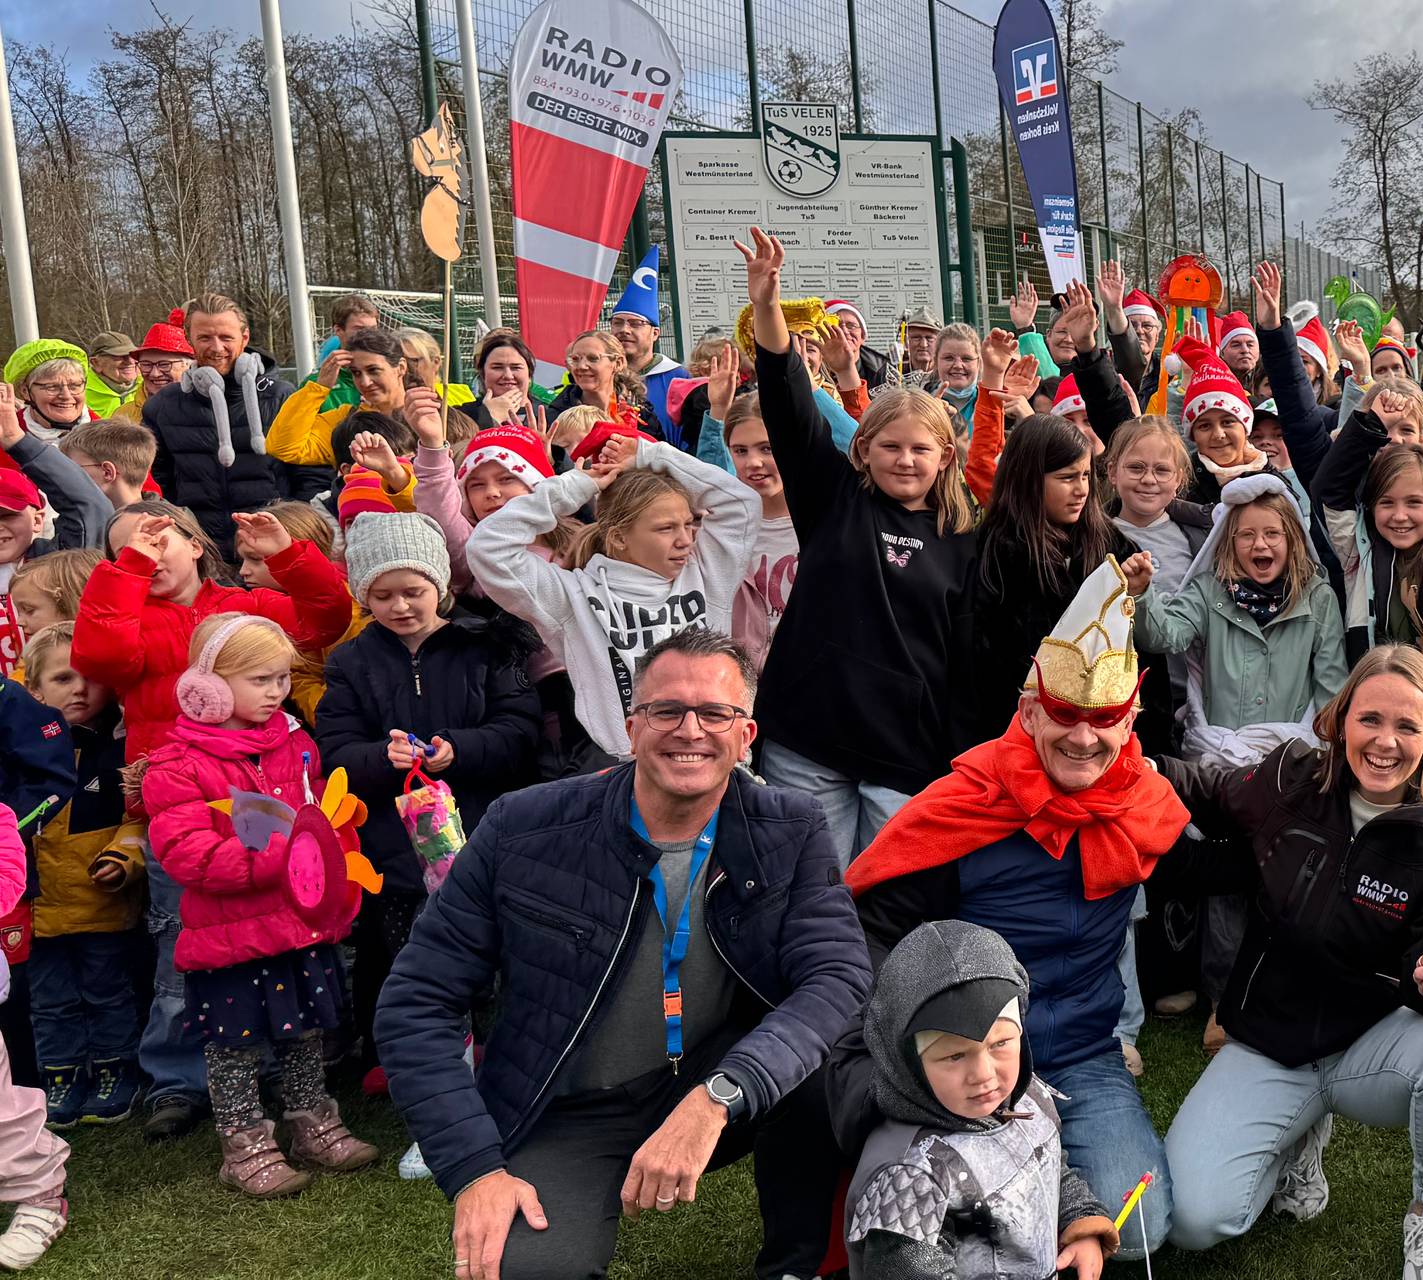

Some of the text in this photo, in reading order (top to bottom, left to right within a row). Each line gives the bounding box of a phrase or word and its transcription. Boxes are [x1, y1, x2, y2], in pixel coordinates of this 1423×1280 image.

[541, 48, 615, 89] WMW
[546, 26, 671, 87] RADIO
[533, 75, 656, 127] 88.4 93.0 97.6 103.6
[765, 107, 833, 118] TuS VELEN
[534, 96, 642, 145] DER BESTE MIX.
[802, 125, 832, 137] 1925
[685, 170, 753, 178] Westmünsterland
[1356, 884, 1387, 903] WMW
[1360, 874, 1409, 902] RADIO
